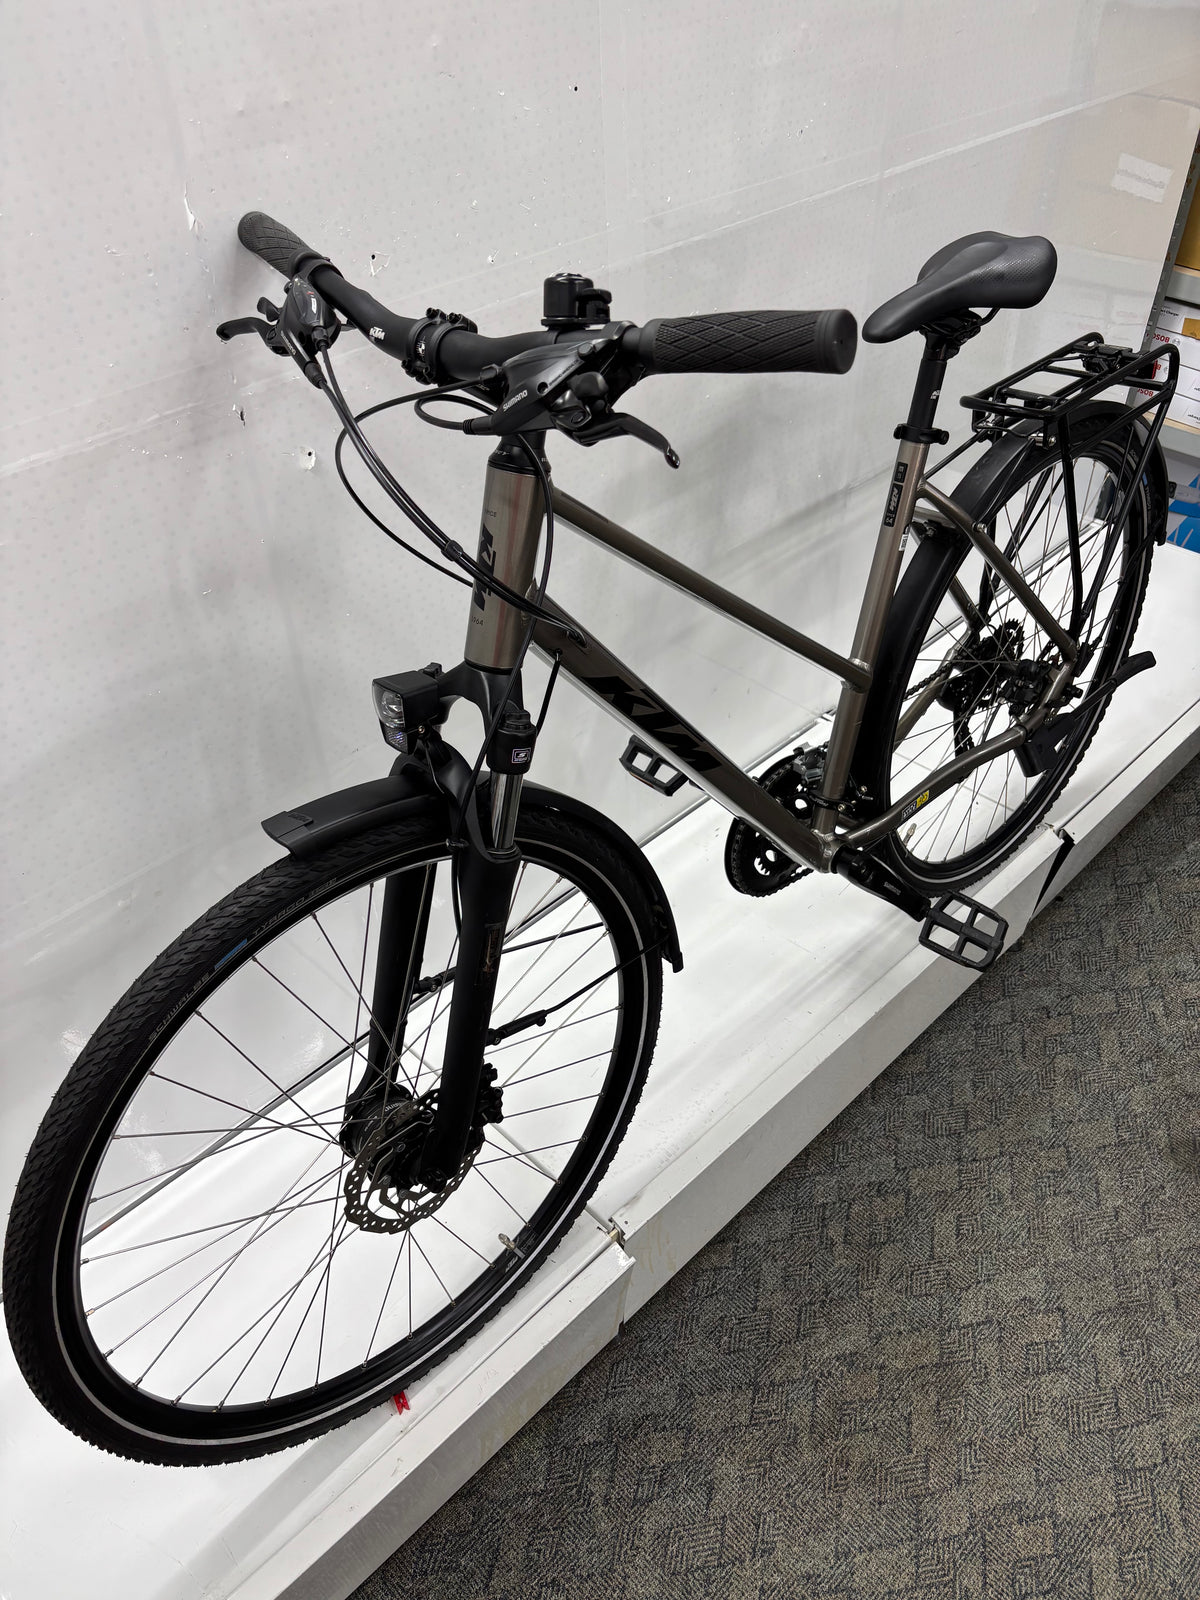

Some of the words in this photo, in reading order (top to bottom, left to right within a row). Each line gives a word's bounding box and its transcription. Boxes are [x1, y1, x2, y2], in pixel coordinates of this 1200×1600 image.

[369, 326, 386, 340] KTM
[502, 389, 528, 412] SHIMANO
[580, 675, 723, 772] KTM
[148, 972, 211, 1040] SCHWALBE
